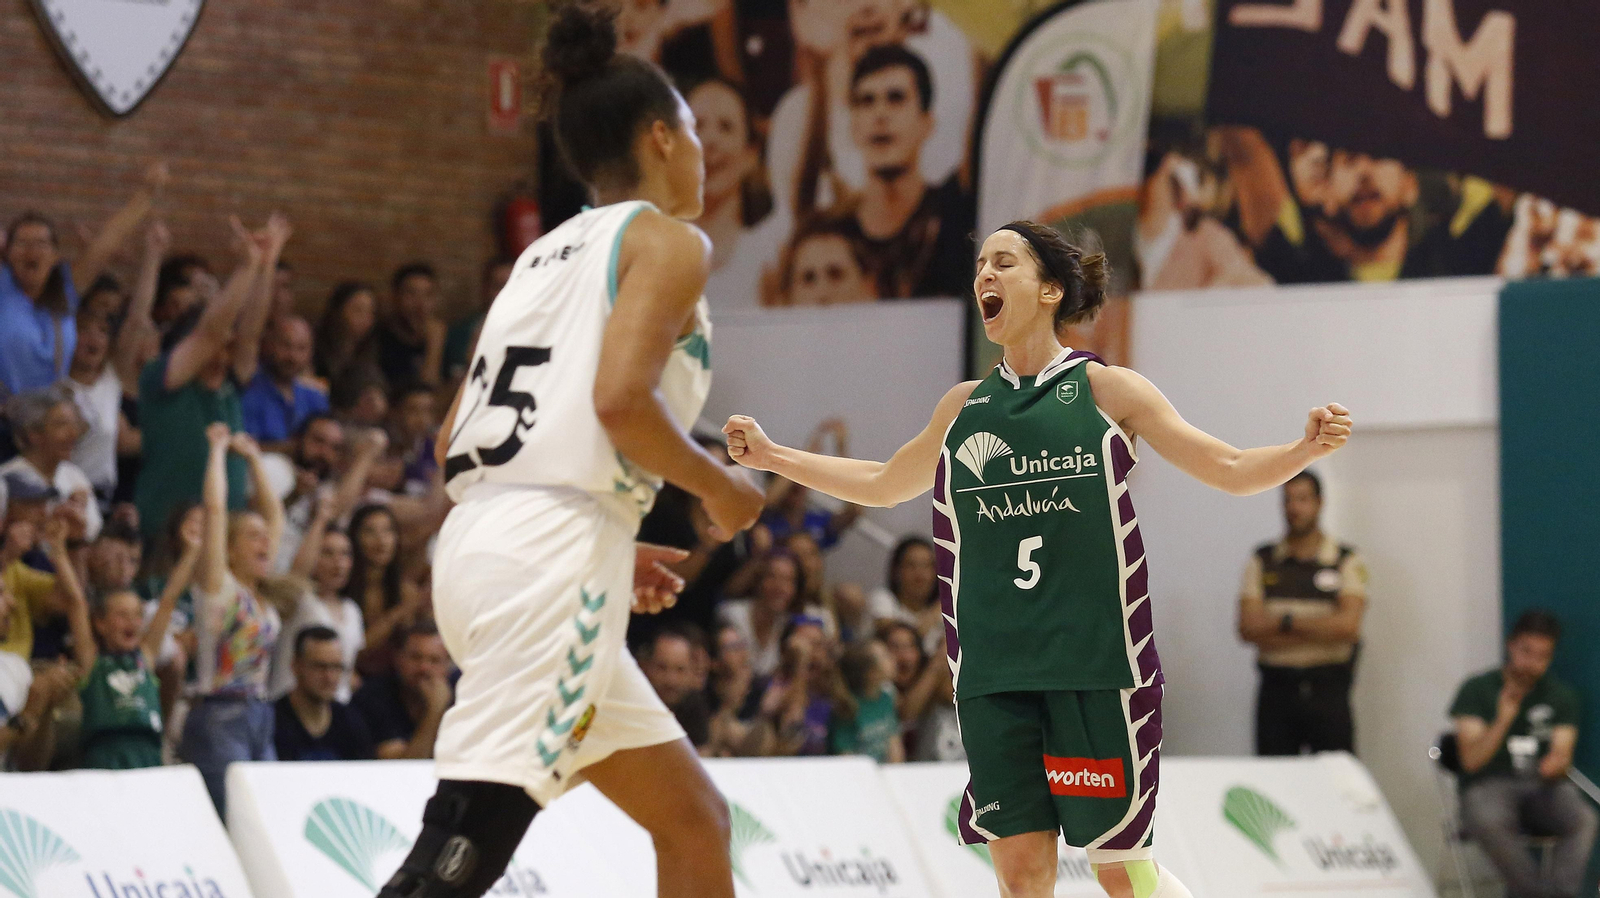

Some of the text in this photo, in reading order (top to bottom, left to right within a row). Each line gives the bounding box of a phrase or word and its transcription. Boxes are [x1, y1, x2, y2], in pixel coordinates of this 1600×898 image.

[963, 394, 992, 408] SPALDING
[1009, 445, 1098, 476] Unicaja
[975, 485, 1081, 523] Andalucía
[1013, 535, 1043, 590] 5
[1045, 768, 1115, 788] worten
